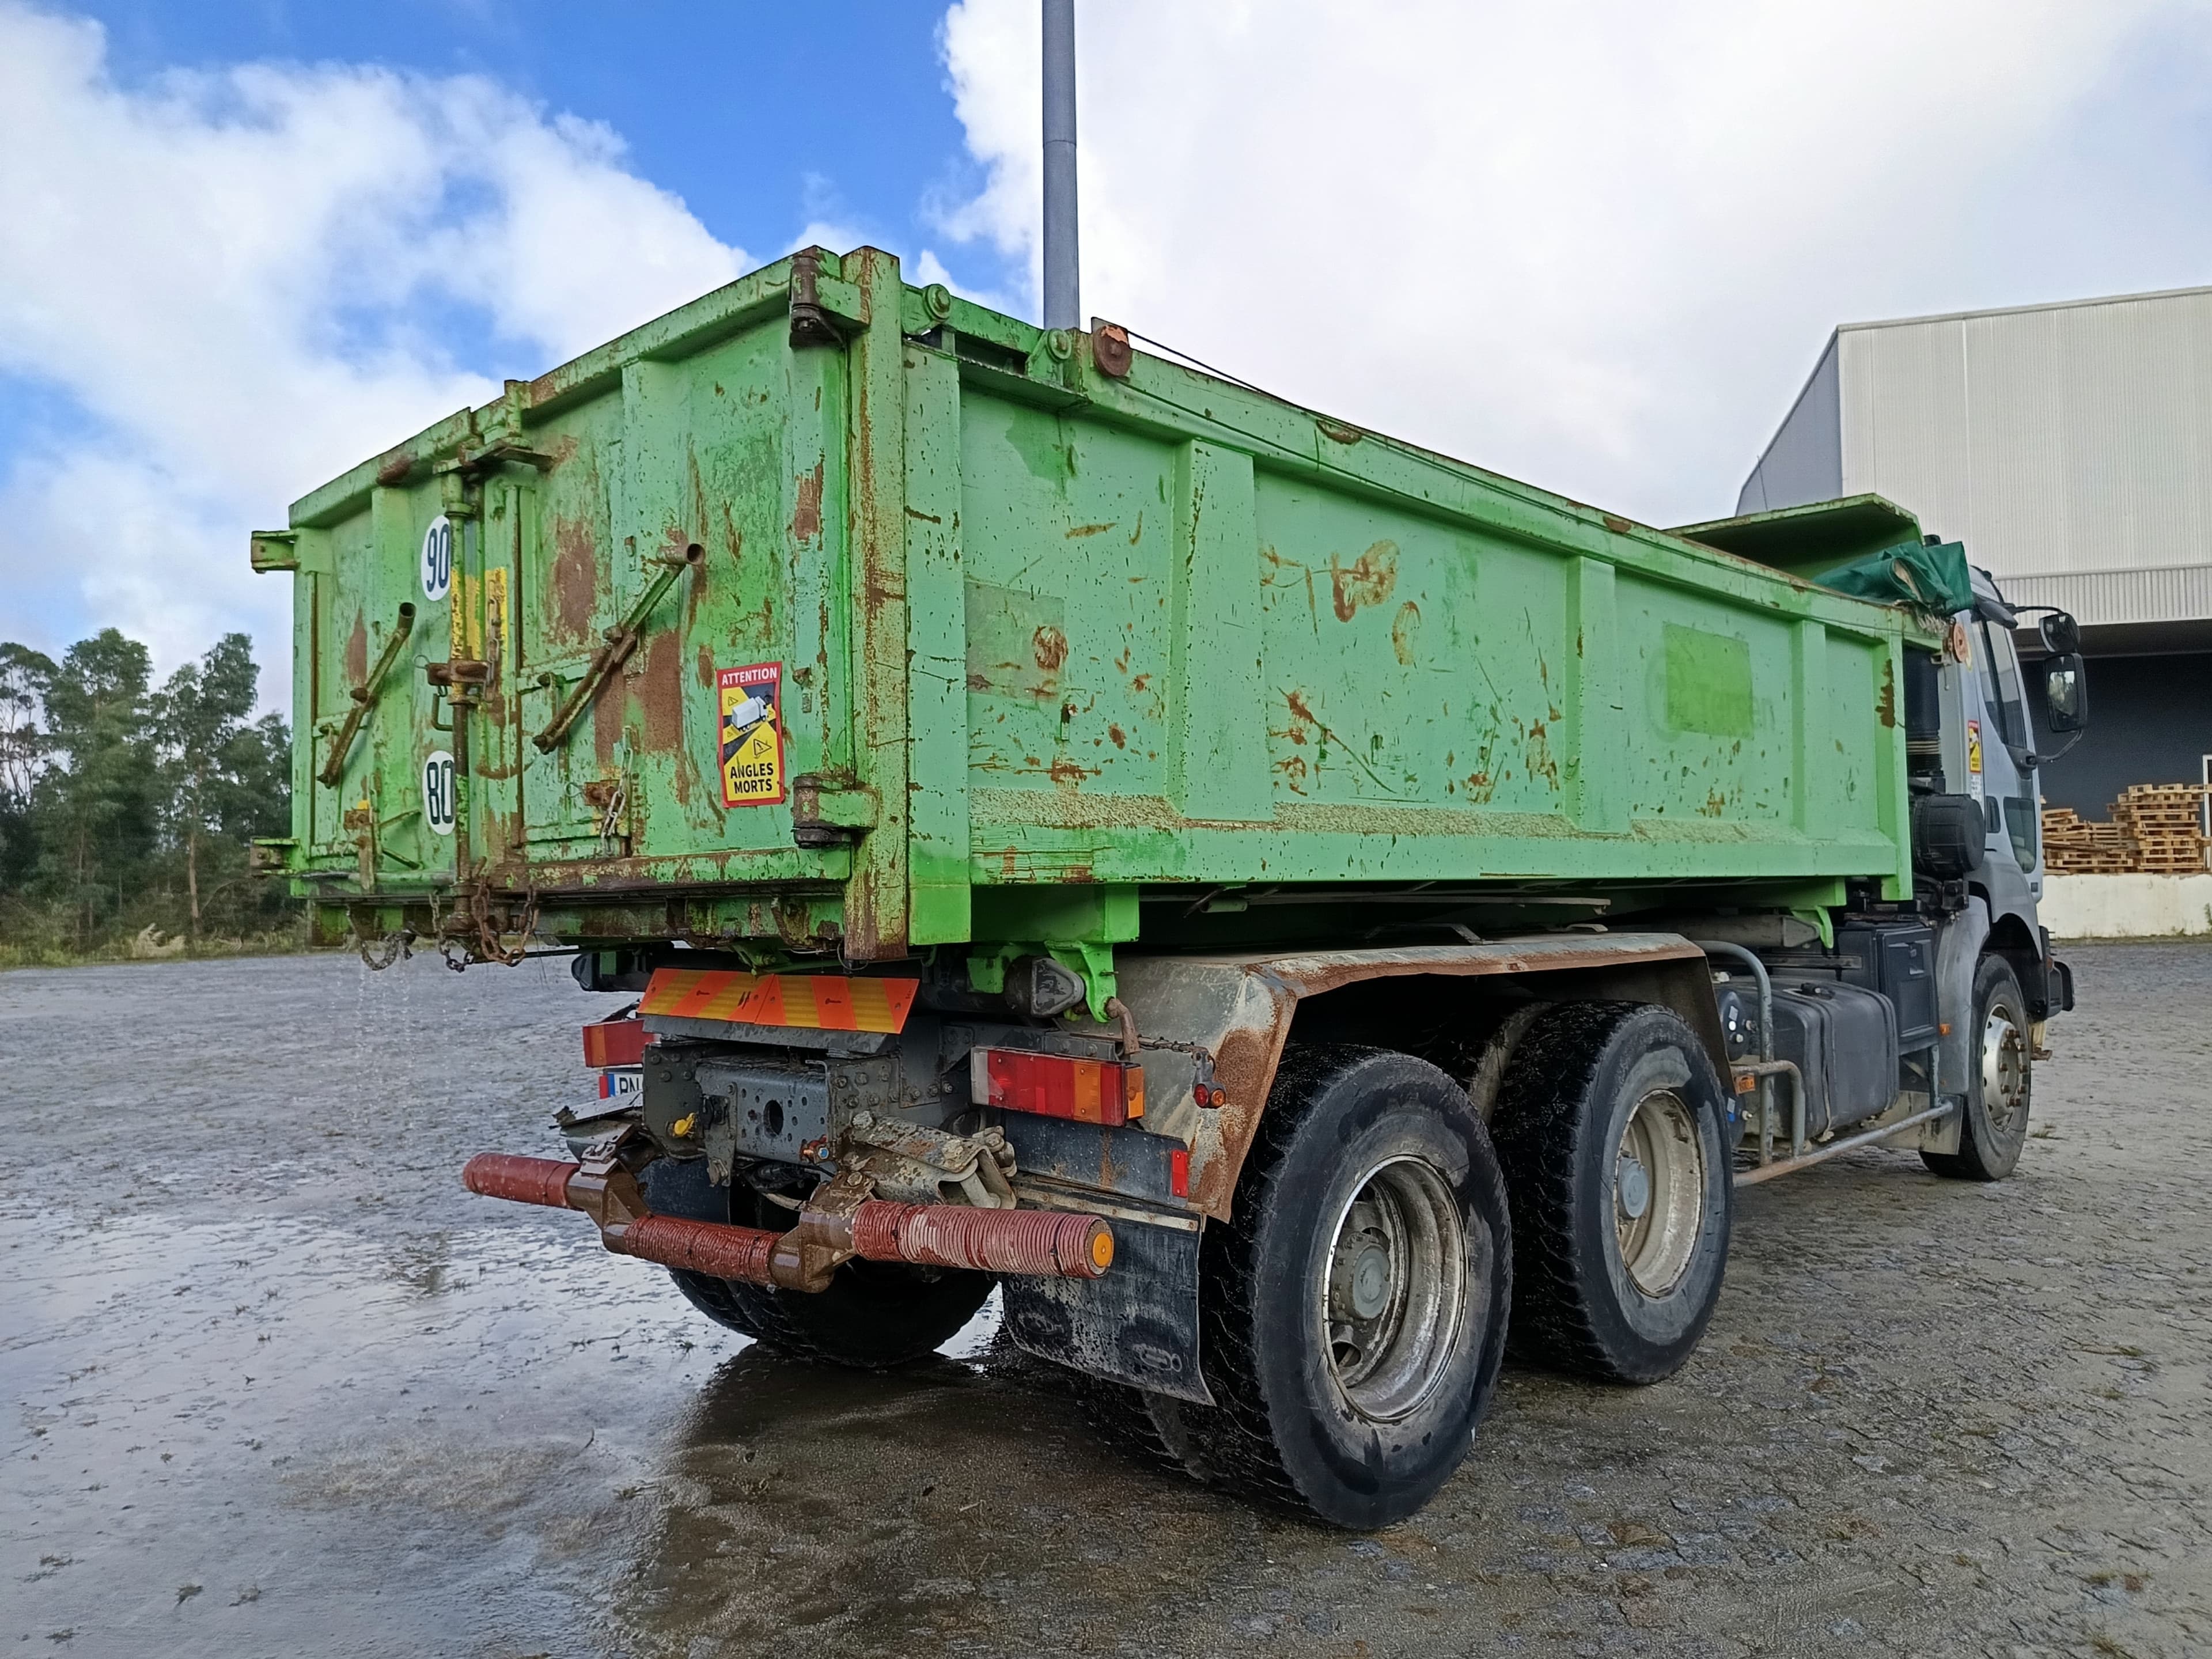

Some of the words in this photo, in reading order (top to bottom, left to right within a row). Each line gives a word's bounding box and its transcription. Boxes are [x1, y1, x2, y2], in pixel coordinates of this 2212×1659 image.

[427, 523, 449, 592] 90
[722, 667, 777, 685] ATTENTION
[730, 762, 774, 779] ANGLES
[427, 760, 456, 825] 80
[734, 779, 772, 794] MORTS
